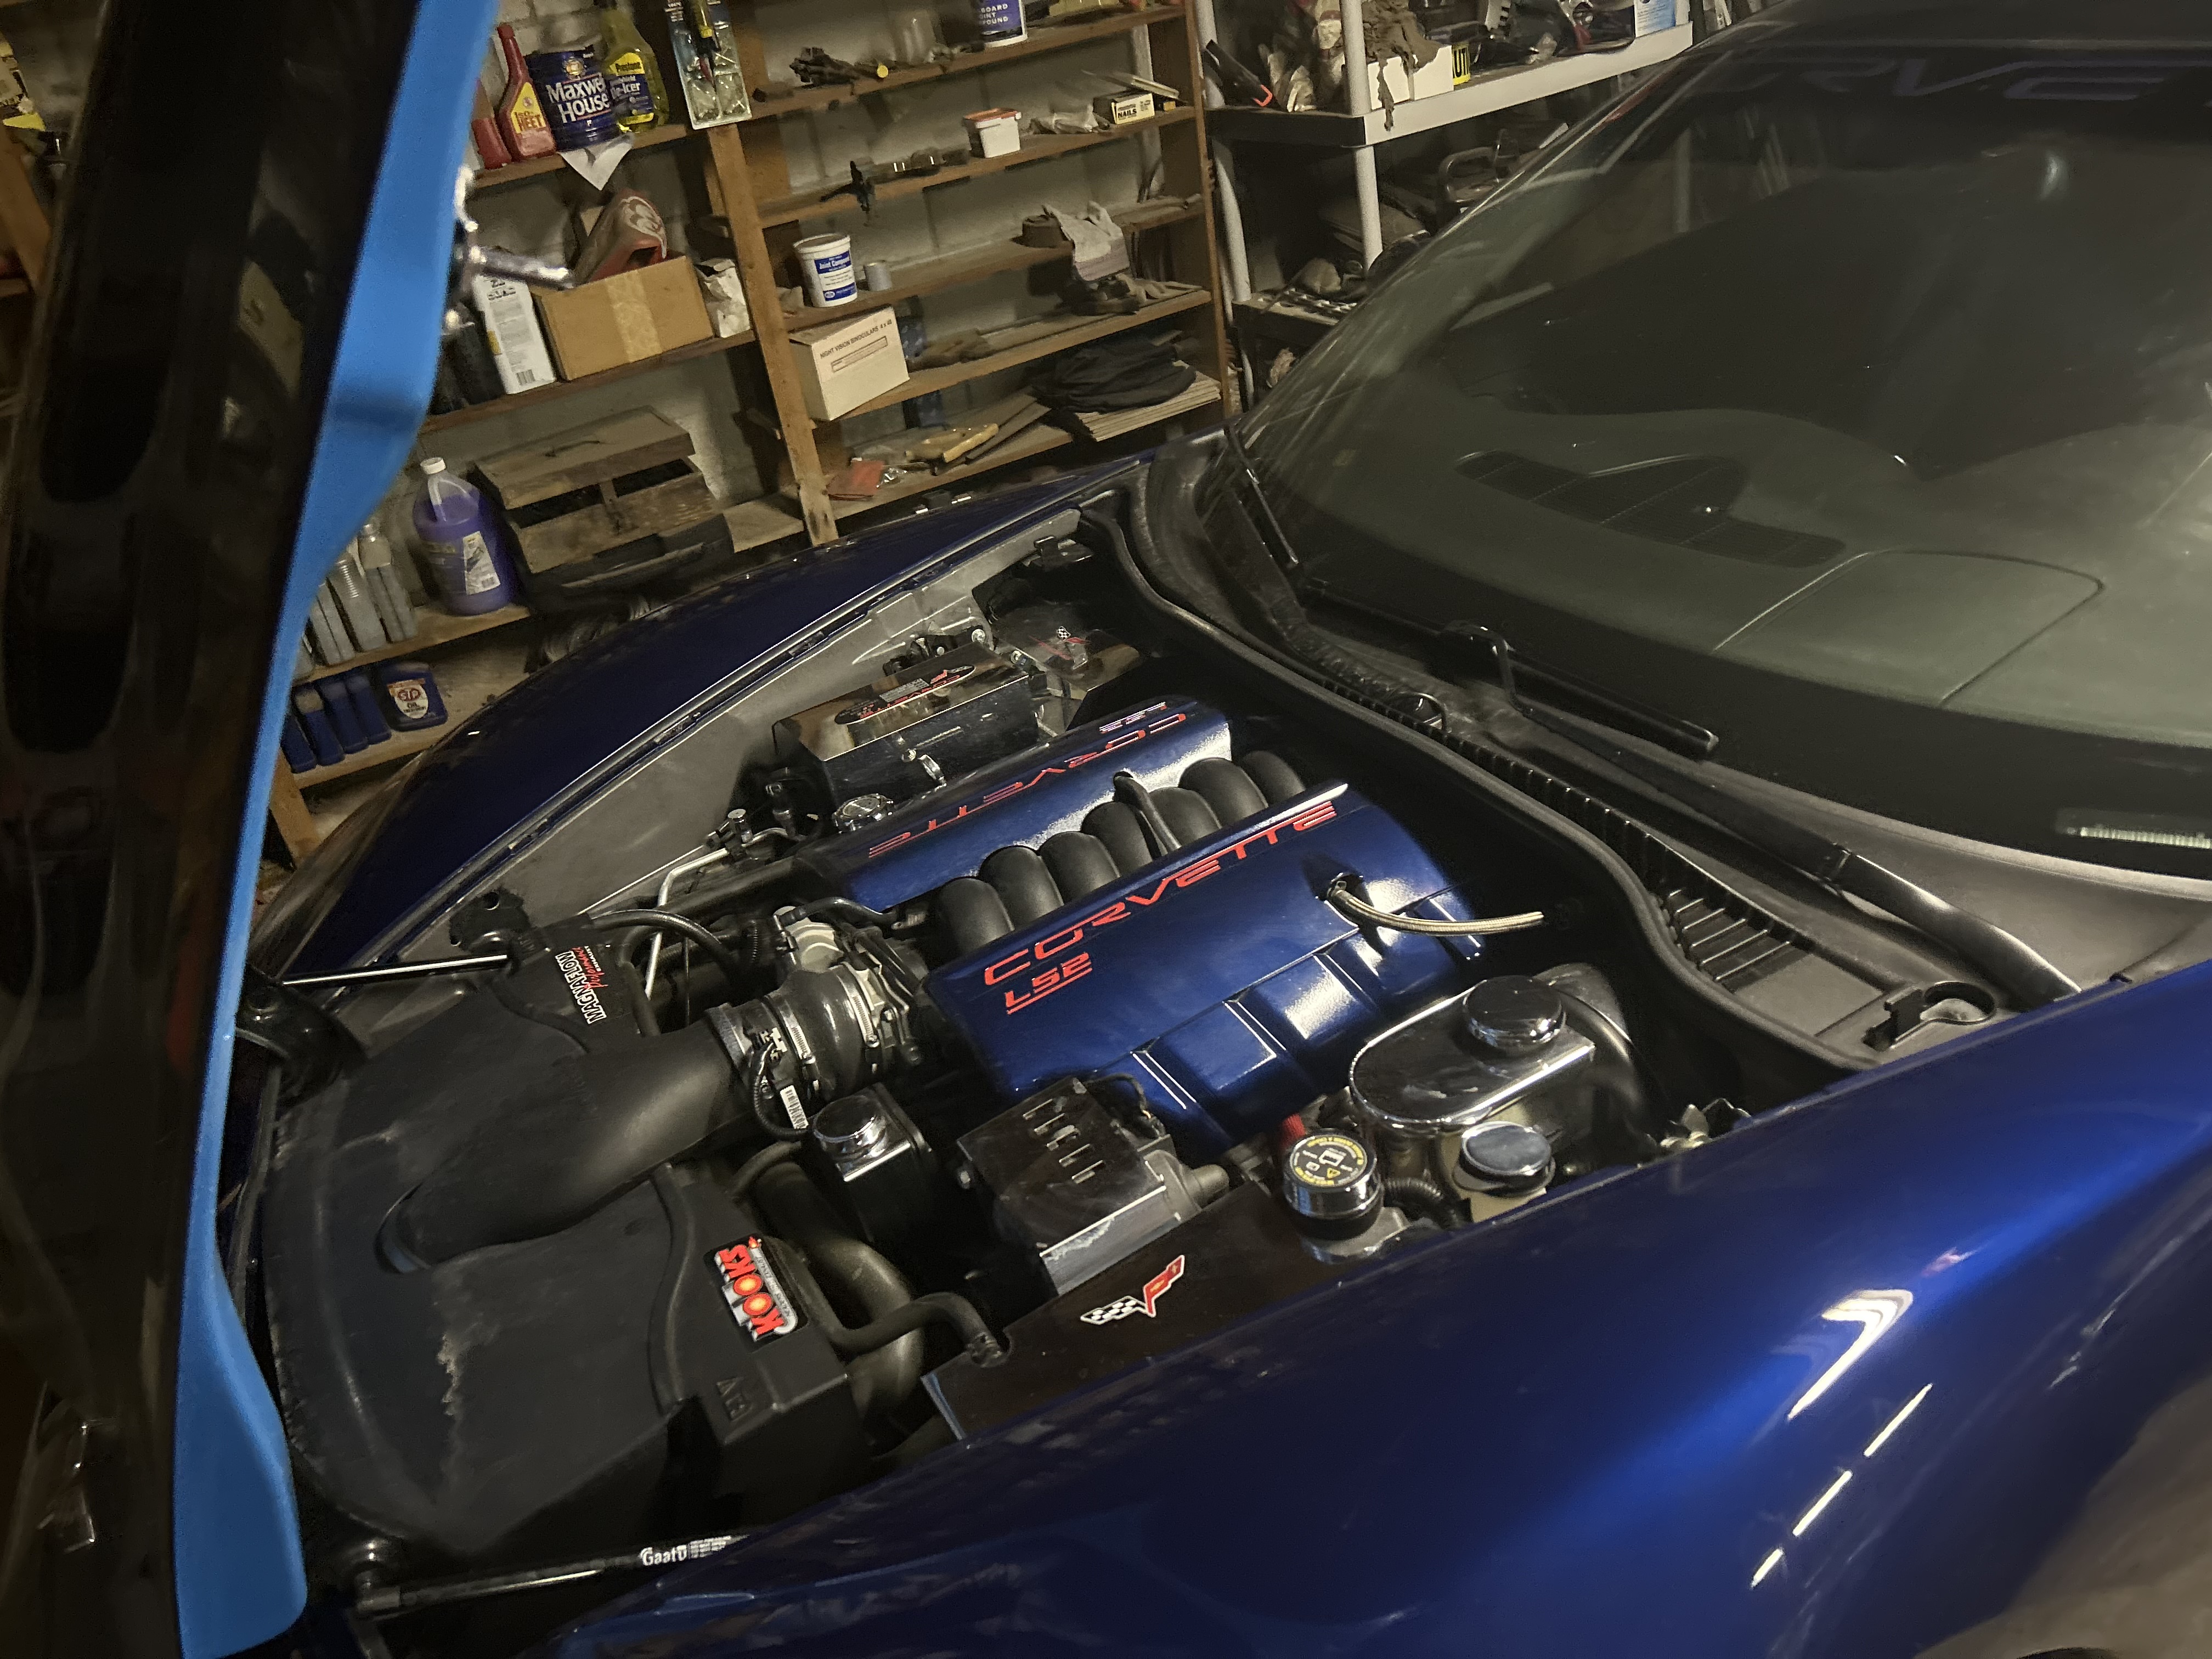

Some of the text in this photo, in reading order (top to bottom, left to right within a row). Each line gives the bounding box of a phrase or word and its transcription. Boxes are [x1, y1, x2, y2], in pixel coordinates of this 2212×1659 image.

[557, 93, 610, 123] House
[1118, 108, 1137, 119] NAILS
[820, 347, 834, 359] NIGHT
[834, 340, 850, 352] VISION
[850, 326, 879, 344] BINOCULARS
[398, 688, 421, 701] STP
[868, 713, 1187, 859] CORVETTE
[984, 801, 1338, 986] CORVETTE
[584, 945, 602, 972] EXHAUST
[555, 950, 607, 1025] MAGNAFLOW
[1004, 952, 1092, 1012] LS2
[716, 1243, 785, 1339] KOOKS
